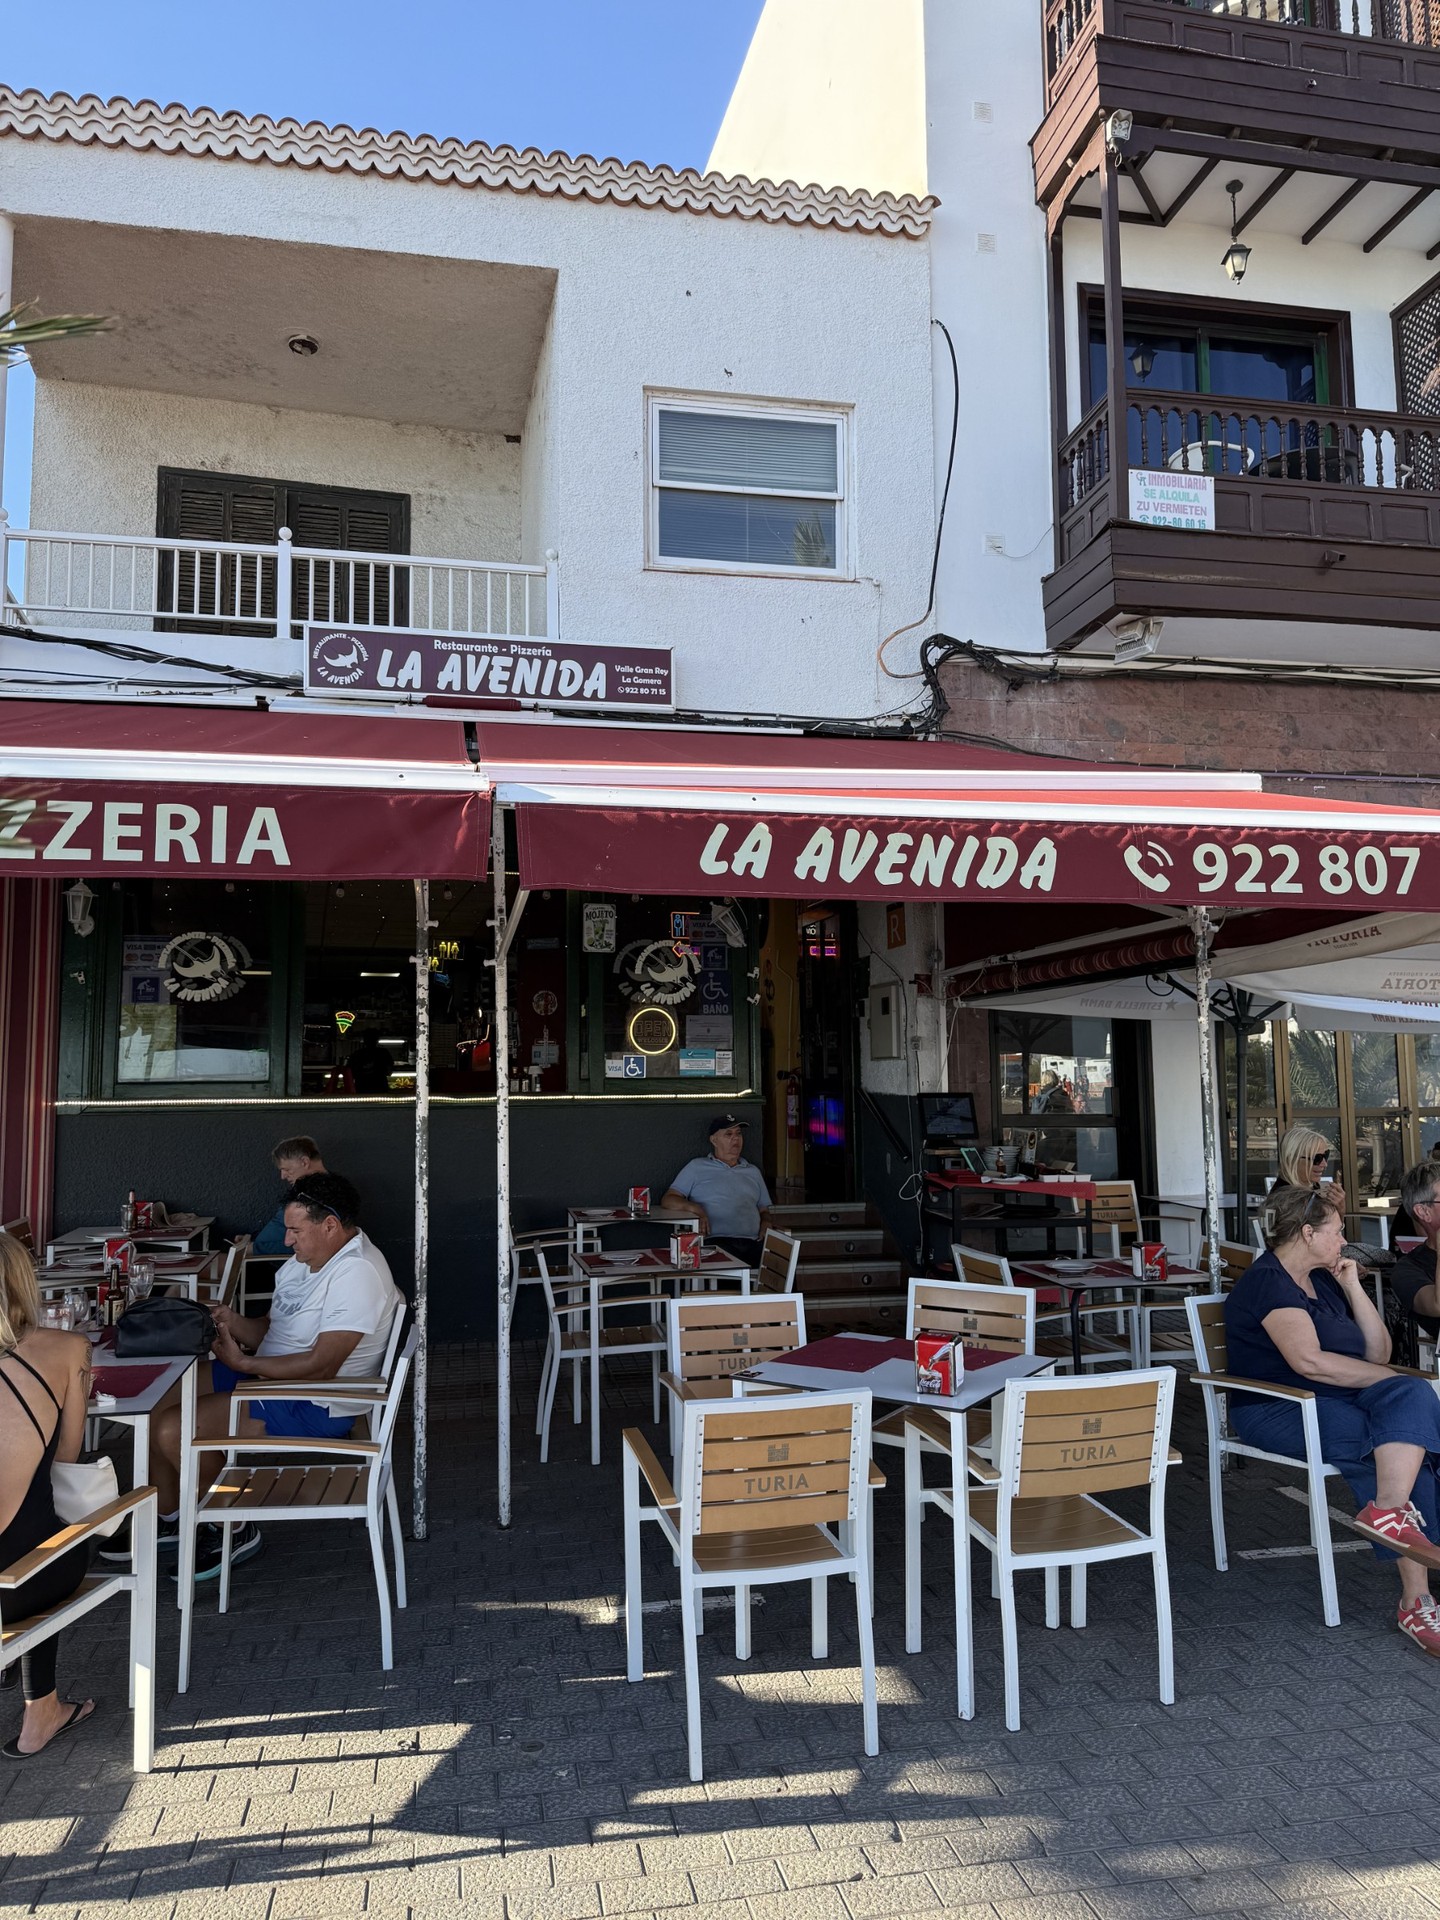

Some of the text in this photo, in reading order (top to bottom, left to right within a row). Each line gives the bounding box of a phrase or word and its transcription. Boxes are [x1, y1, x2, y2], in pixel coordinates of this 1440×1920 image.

[1148, 473, 1207, 490] INMOBILIARIA
[1143, 488, 1200, 503] SE ALQUILA
[1136, 501, 1207, 516] ZU VERMIETEN
[433, 639, 499, 654] Restaurante
[510, 644, 552, 657] Pizzería
[317, 667, 364, 685] LA AVENIDA
[377, 649, 606, 698] LA AVENIDA
[614, 664, 669, 676] Valle Gran Rey
[621, 675, 662, 685] La Gomera
[625, 686, 639, 694] 922
[700, 822, 1058, 891] LA AVENIDA
[1193, 843, 1421, 895] 922 807
[586, 910, 614, 921] MOJITO
[889, 914, 901, 944] R
[702, 1001, 729, 1014] BAÑO
[634, 1020, 672, 1037] OPEN
[1060, 1444, 1117, 1464] TURIA
[744, 1473, 809, 1495] TURIA
